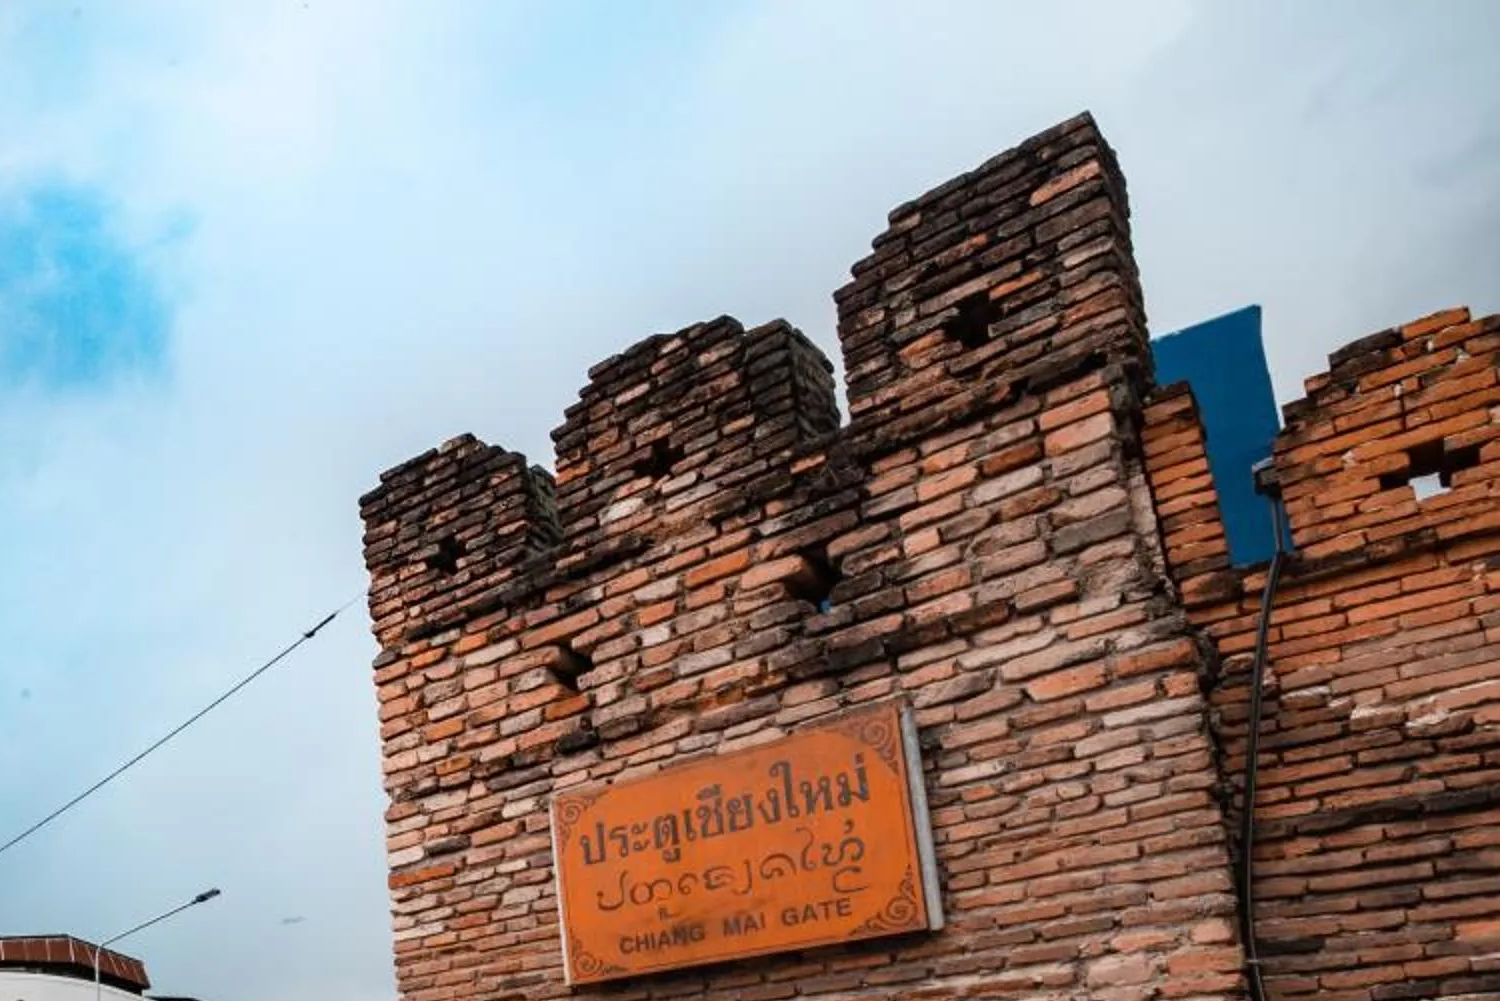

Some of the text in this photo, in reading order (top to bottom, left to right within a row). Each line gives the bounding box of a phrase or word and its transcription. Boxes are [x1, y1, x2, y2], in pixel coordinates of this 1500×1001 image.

[579, 752, 870, 865] ประตูเชียงใหม่
[619, 897, 853, 955] CHIANG MAI GATE
